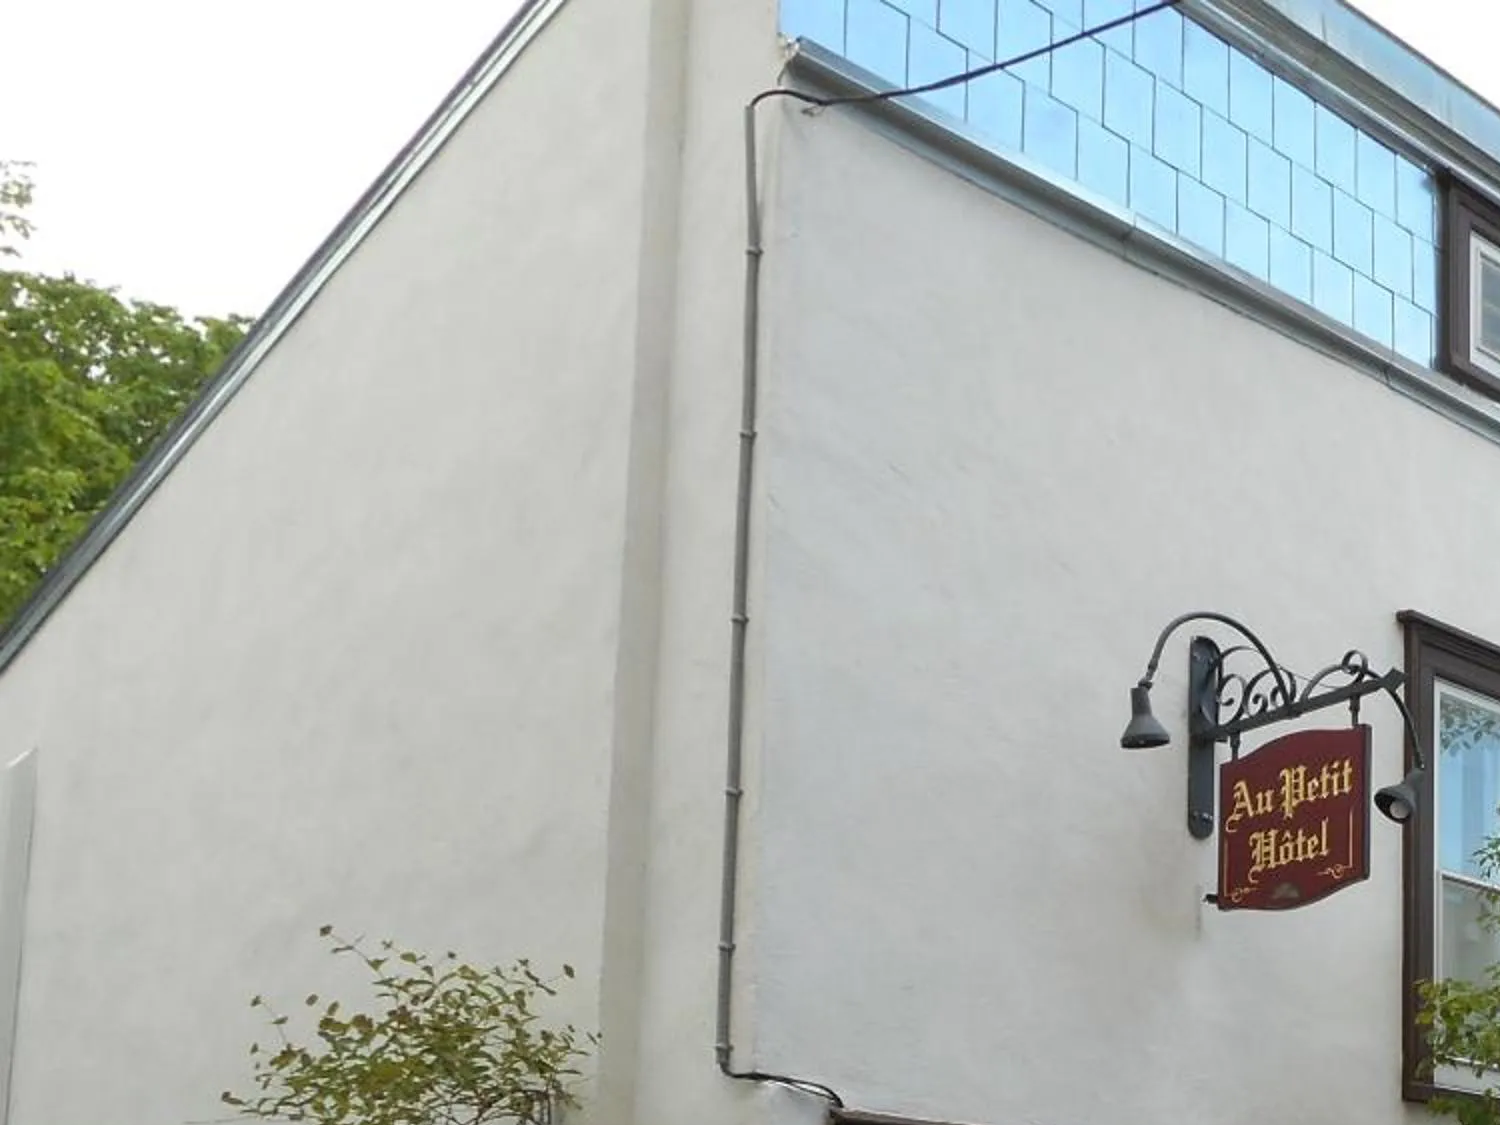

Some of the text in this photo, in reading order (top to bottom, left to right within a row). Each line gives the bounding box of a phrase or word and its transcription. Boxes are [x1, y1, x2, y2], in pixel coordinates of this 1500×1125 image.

[1225, 758, 1353, 833] Au Petit
[1247, 816, 1331, 883] Hôtel
